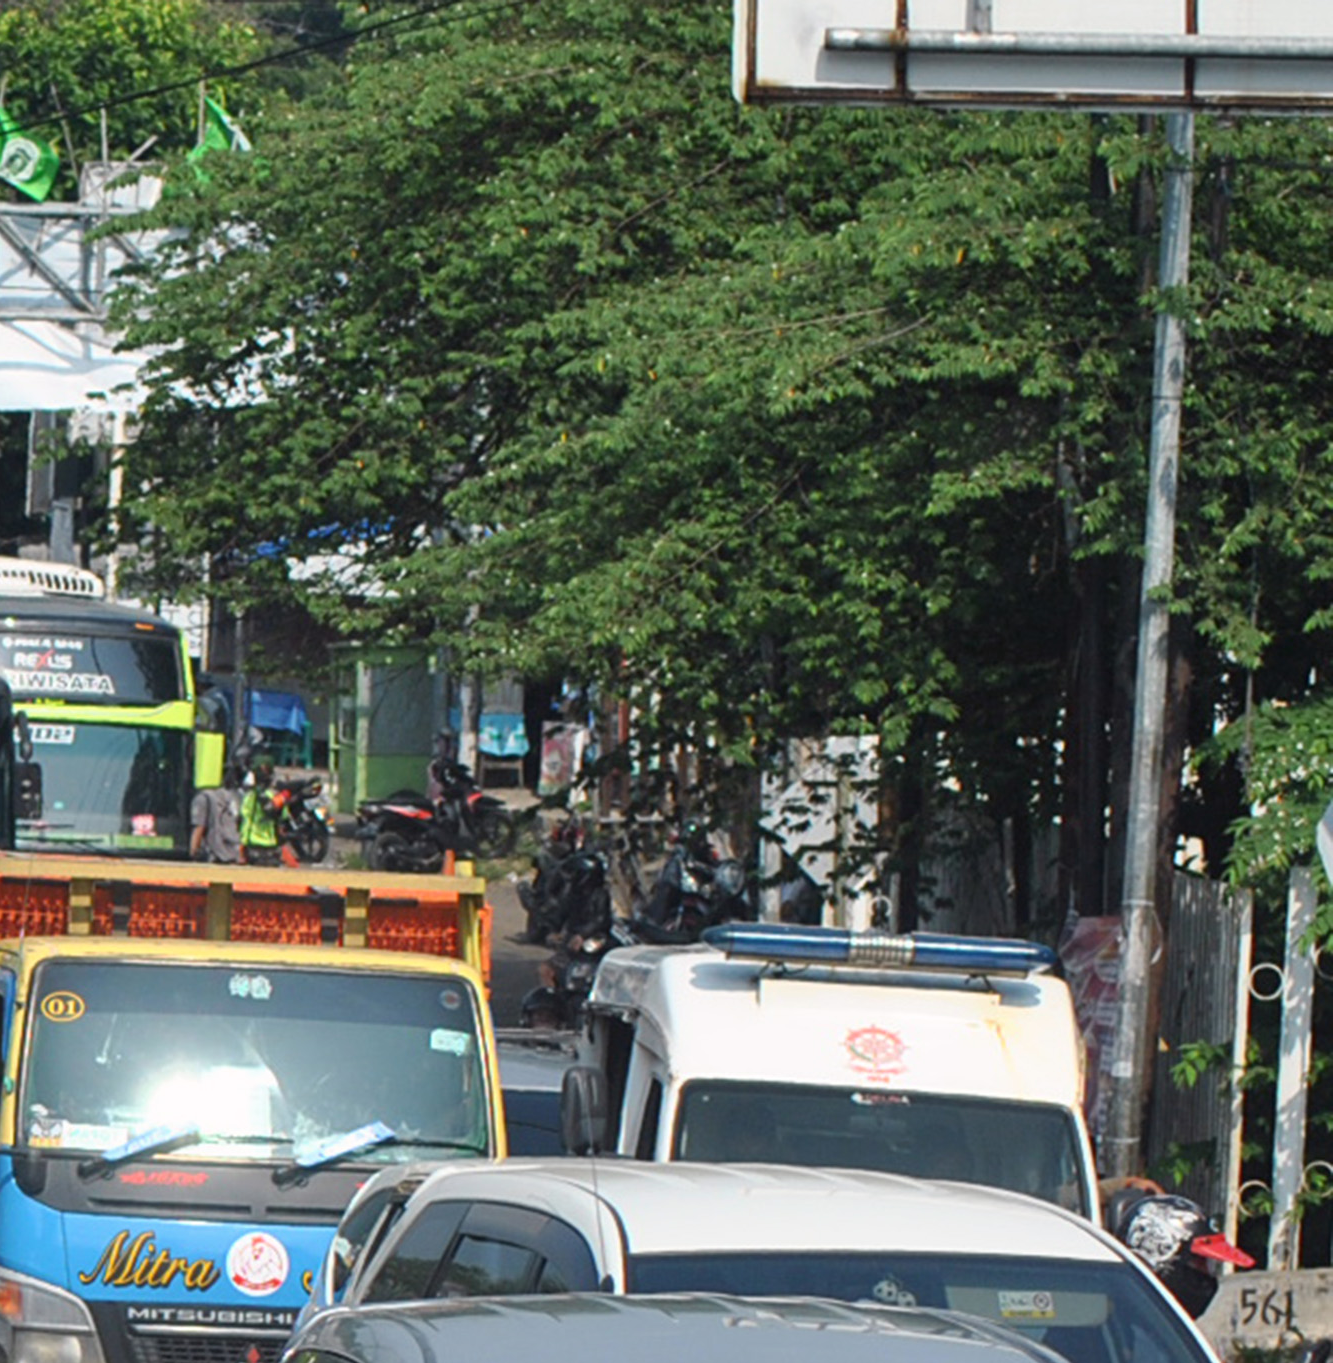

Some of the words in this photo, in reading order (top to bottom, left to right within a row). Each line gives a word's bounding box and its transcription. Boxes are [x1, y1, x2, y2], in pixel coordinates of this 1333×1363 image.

[48, 999, 77, 1015] 01
[79, 1230, 221, 1288] Mitra
[127, 1307, 293, 1325] MITSUBISHI
